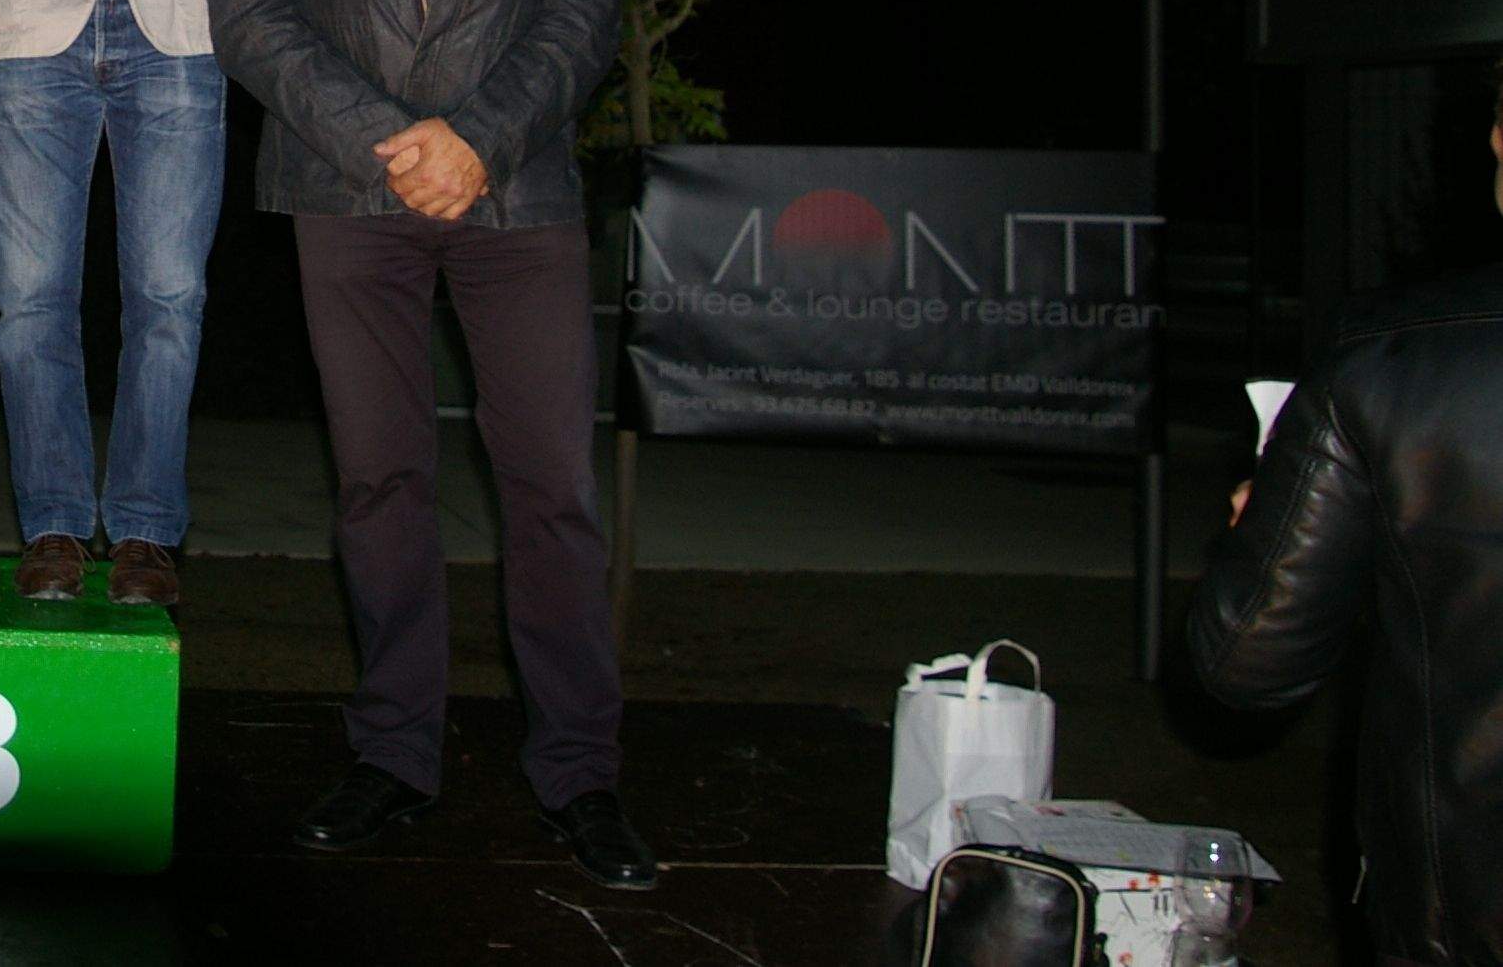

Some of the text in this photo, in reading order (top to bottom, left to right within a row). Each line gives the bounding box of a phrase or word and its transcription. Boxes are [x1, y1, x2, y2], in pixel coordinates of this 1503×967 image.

[624, 285, 1166, 329] coffee & lounge restauran
[864, 369, 900, 389] 185
[928, 374, 988, 392] costat
[990, 374, 1039, 393] EMD
[1041, 376, 1136, 397] Valldoreix
